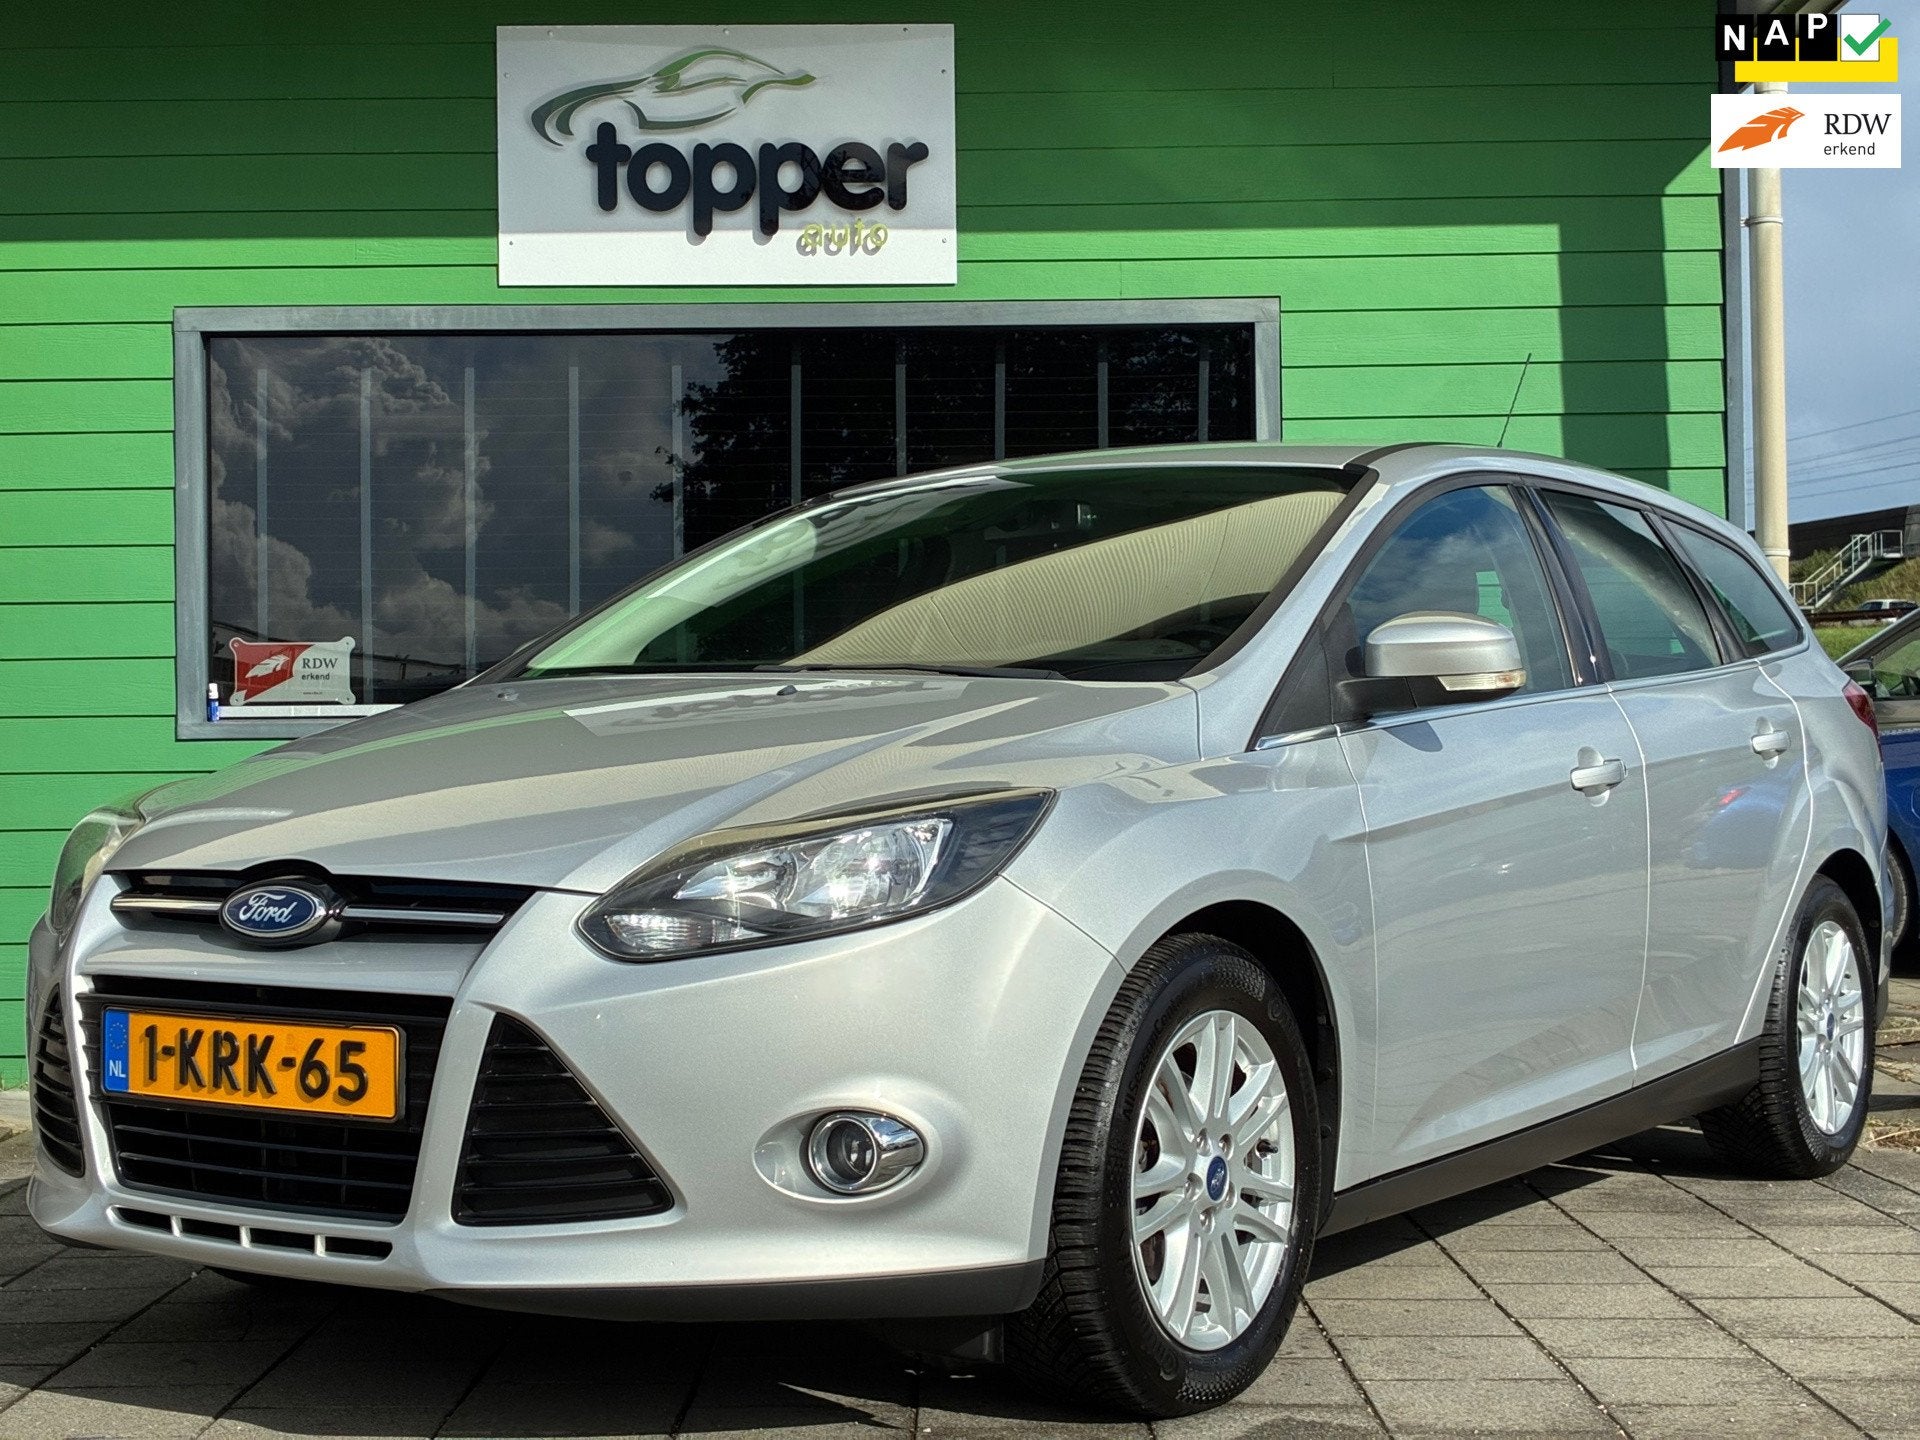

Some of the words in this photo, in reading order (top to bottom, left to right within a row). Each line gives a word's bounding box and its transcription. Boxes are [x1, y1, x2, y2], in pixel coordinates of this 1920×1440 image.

[586, 121, 930, 237] topper
[802, 217, 888, 250] auto
[301, 672, 330, 681] erkend
[302, 657, 338, 669] RDW
[238, 893, 298, 924] Ford
[109, 1060, 127, 1078] NL
[144, 1024, 369, 1101] 1-KRK-65
